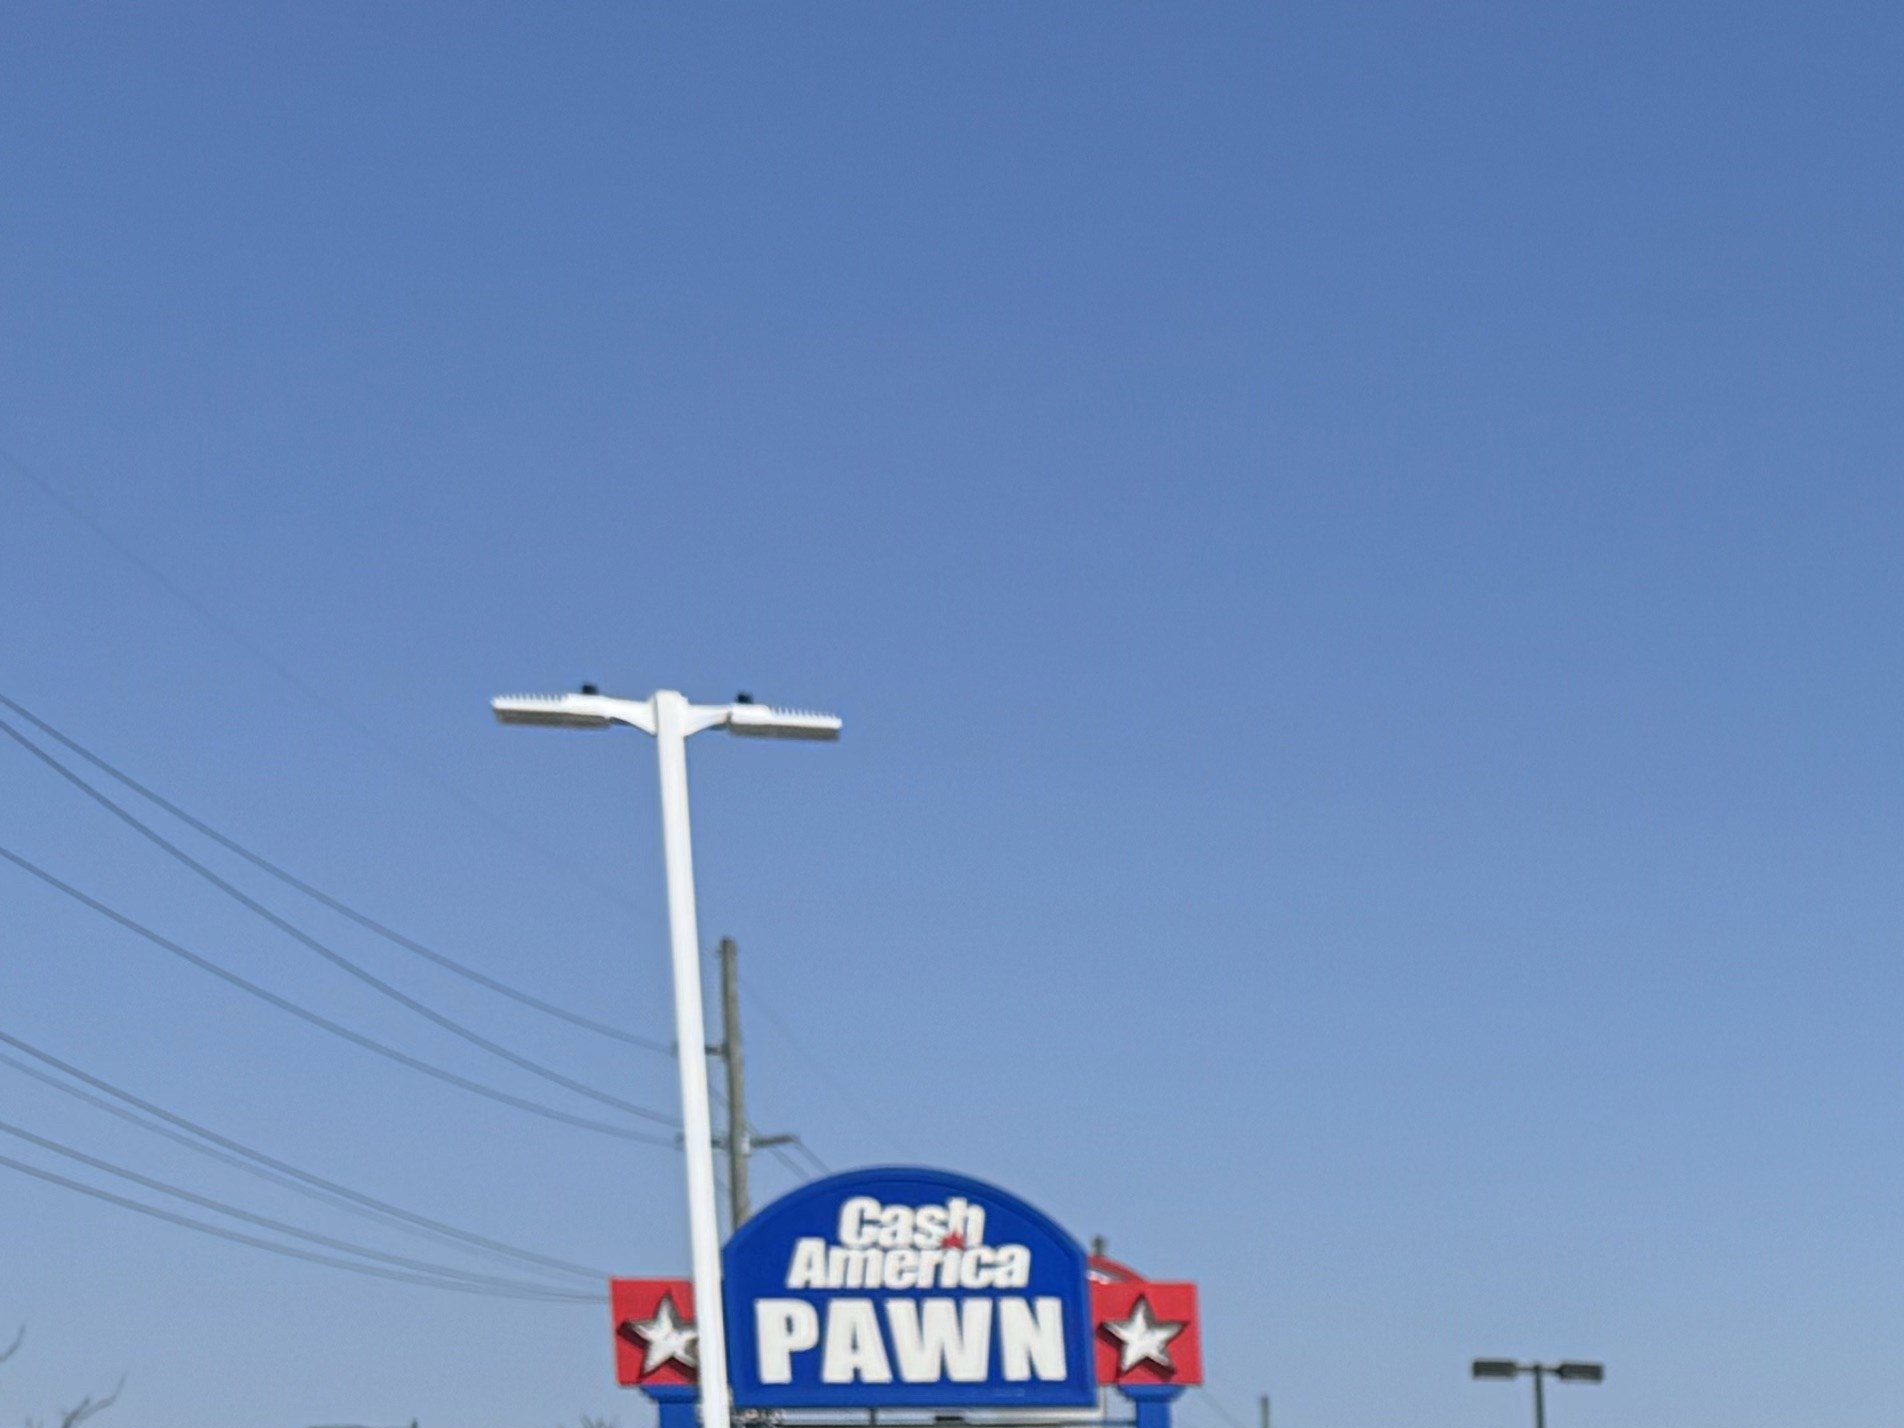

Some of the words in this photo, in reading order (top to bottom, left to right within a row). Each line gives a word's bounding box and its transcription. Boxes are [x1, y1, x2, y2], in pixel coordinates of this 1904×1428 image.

[838, 1196, 985, 1249] Cash
[785, 1236, 1032, 1290] America
[755, 1297, 1067, 1384] PAWN
